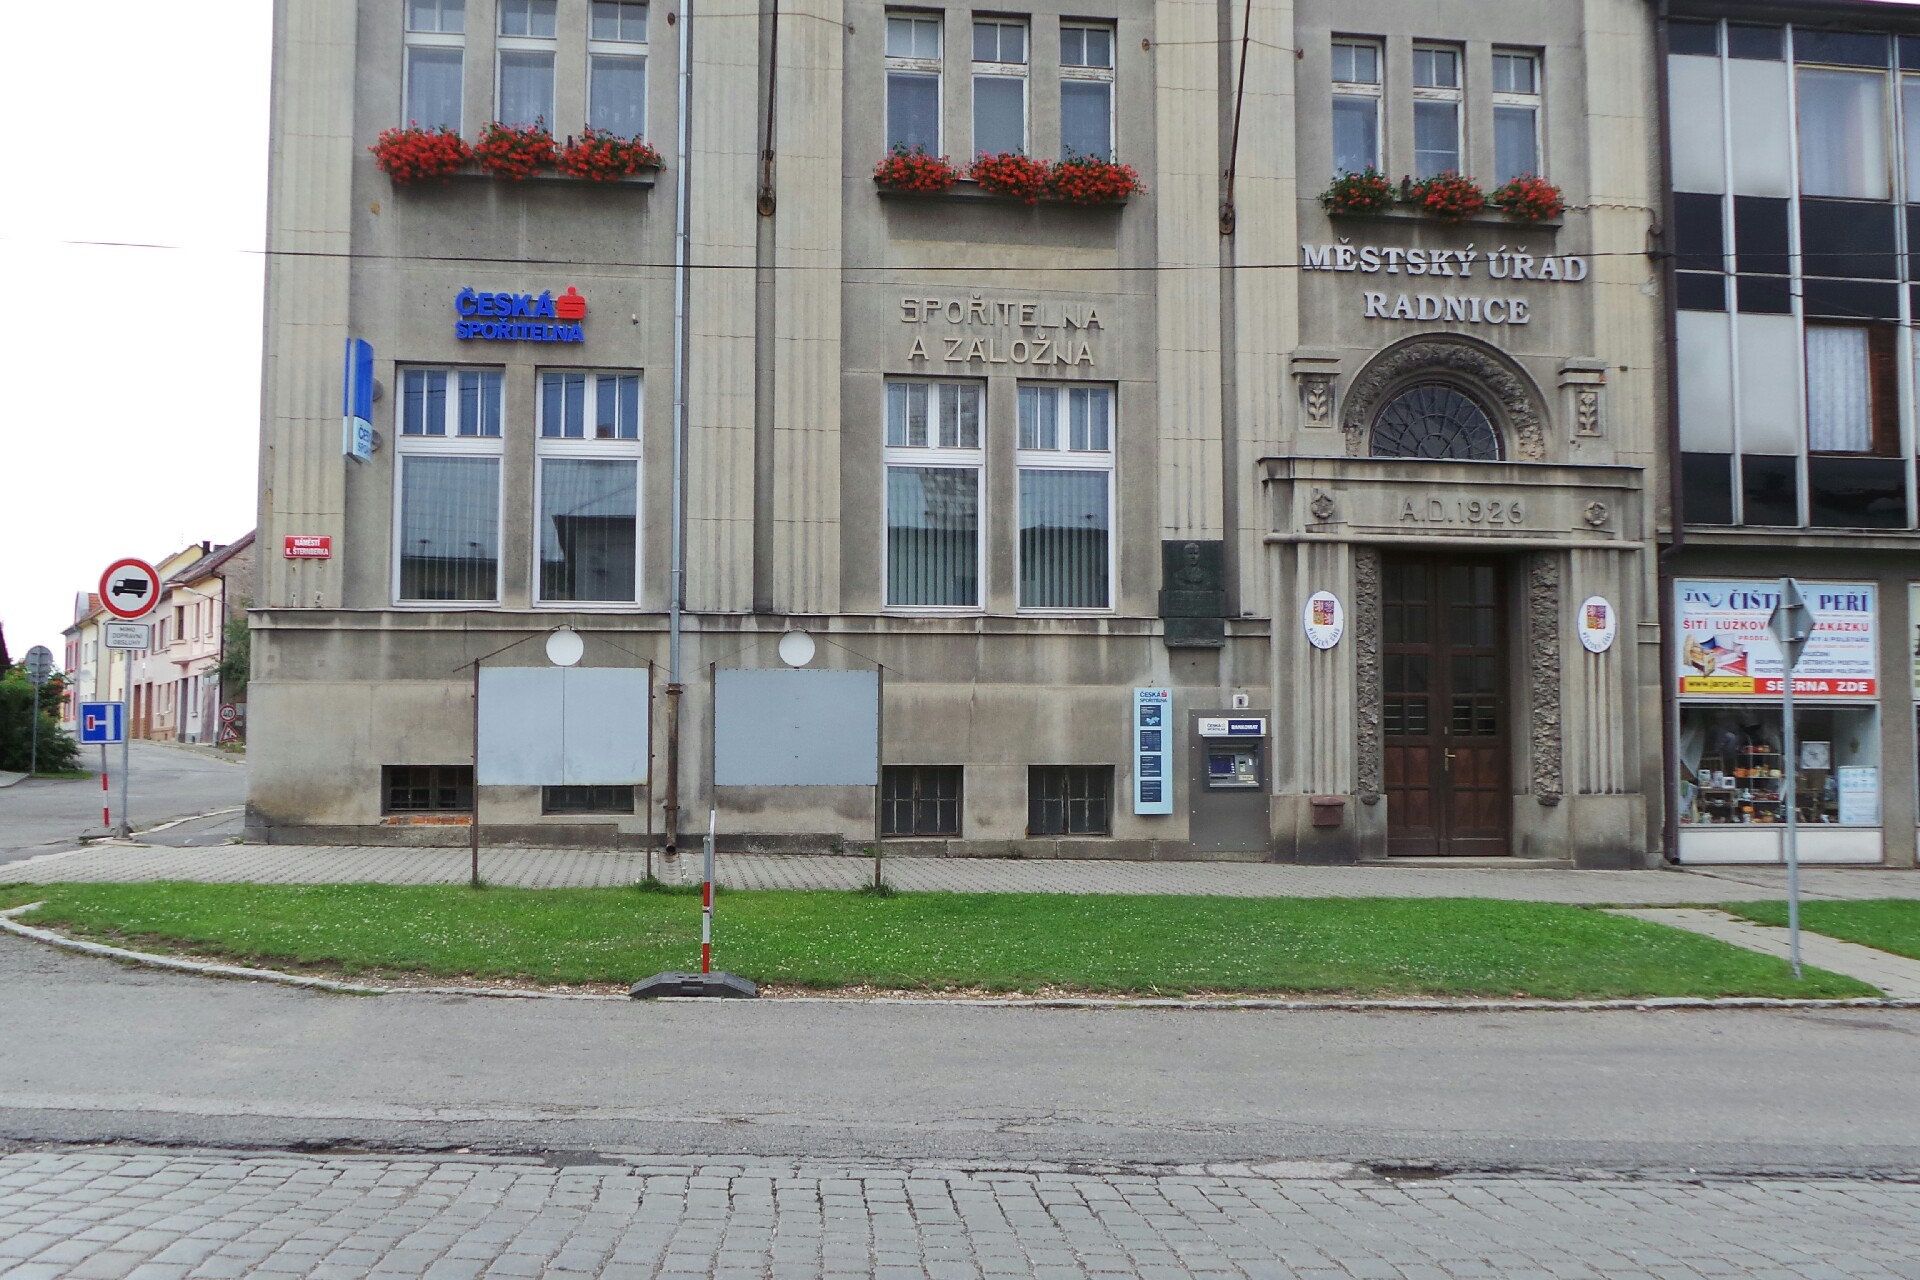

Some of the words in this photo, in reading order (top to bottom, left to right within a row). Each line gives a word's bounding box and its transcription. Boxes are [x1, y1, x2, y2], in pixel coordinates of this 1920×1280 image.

[1301, 237, 1478, 278] MĚSTSKÝ
[1486, 244, 1588, 281] ÚŘAD
[455, 286, 555, 318] ČESKÁ
[900, 292, 1105, 330] SPOŘITELNA
[1364, 290, 1531, 324] RADNICE
[455, 317, 586, 343] SPOŘITELNA
[907, 335, 930, 361] A
[943, 332, 1095, 366] ZÁLOŽNA
[1819, 591, 1869, 612] PEŘÍ
[1683, 618, 1708, 630] ŠITÍ
[1715, 618, 1767, 631] LŮŽKOV
[1810, 620, 1870, 632] ZAKÁZKU
[1140, 690, 1161, 698] ČESKÁ
[1836, 681, 1869, 692] ZDE
[223, 709, 233, 717] 40
